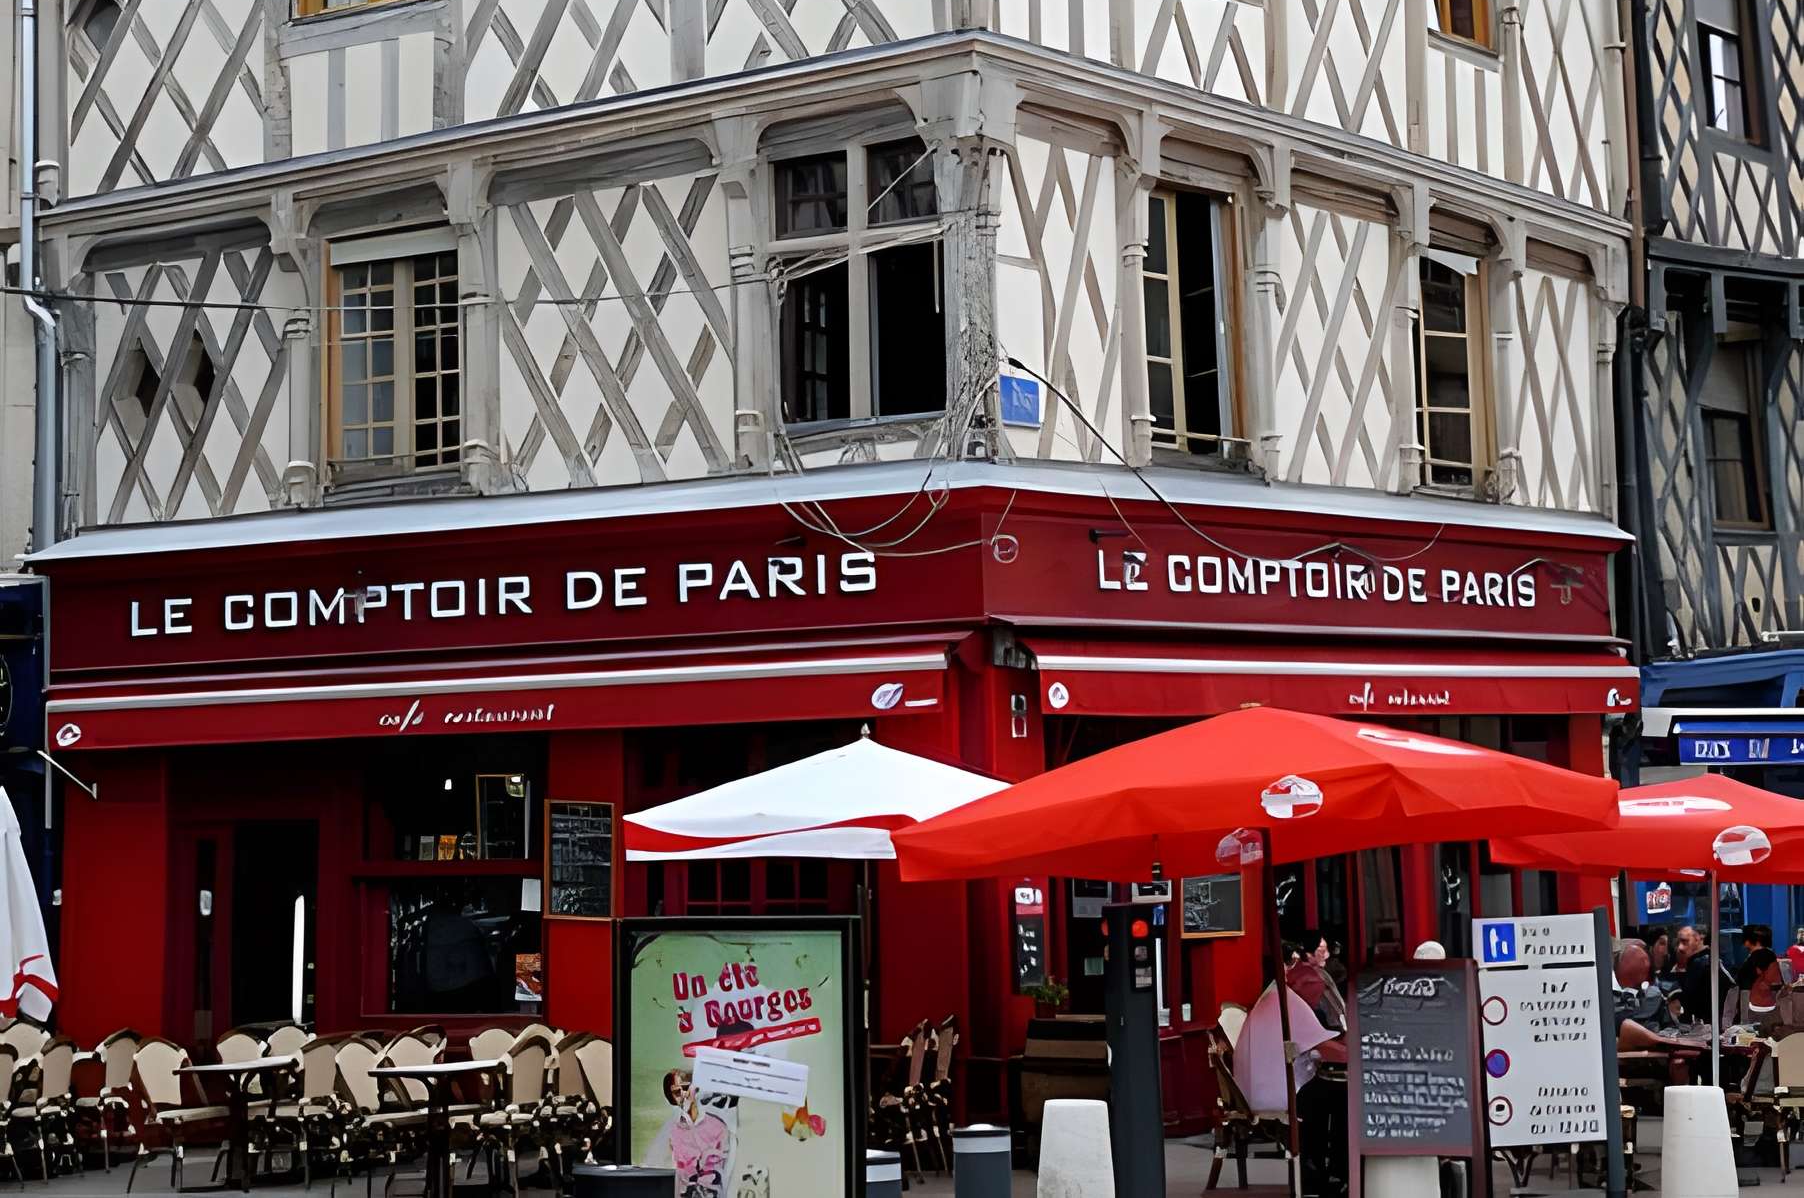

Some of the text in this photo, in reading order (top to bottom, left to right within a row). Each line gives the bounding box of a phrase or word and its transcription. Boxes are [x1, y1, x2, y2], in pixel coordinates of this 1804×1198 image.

[131, 551, 877, 637] LE COMPTOIR DE PARIS
[1098, 549, 1537, 608] LE COMPTOIR DE PARIS
